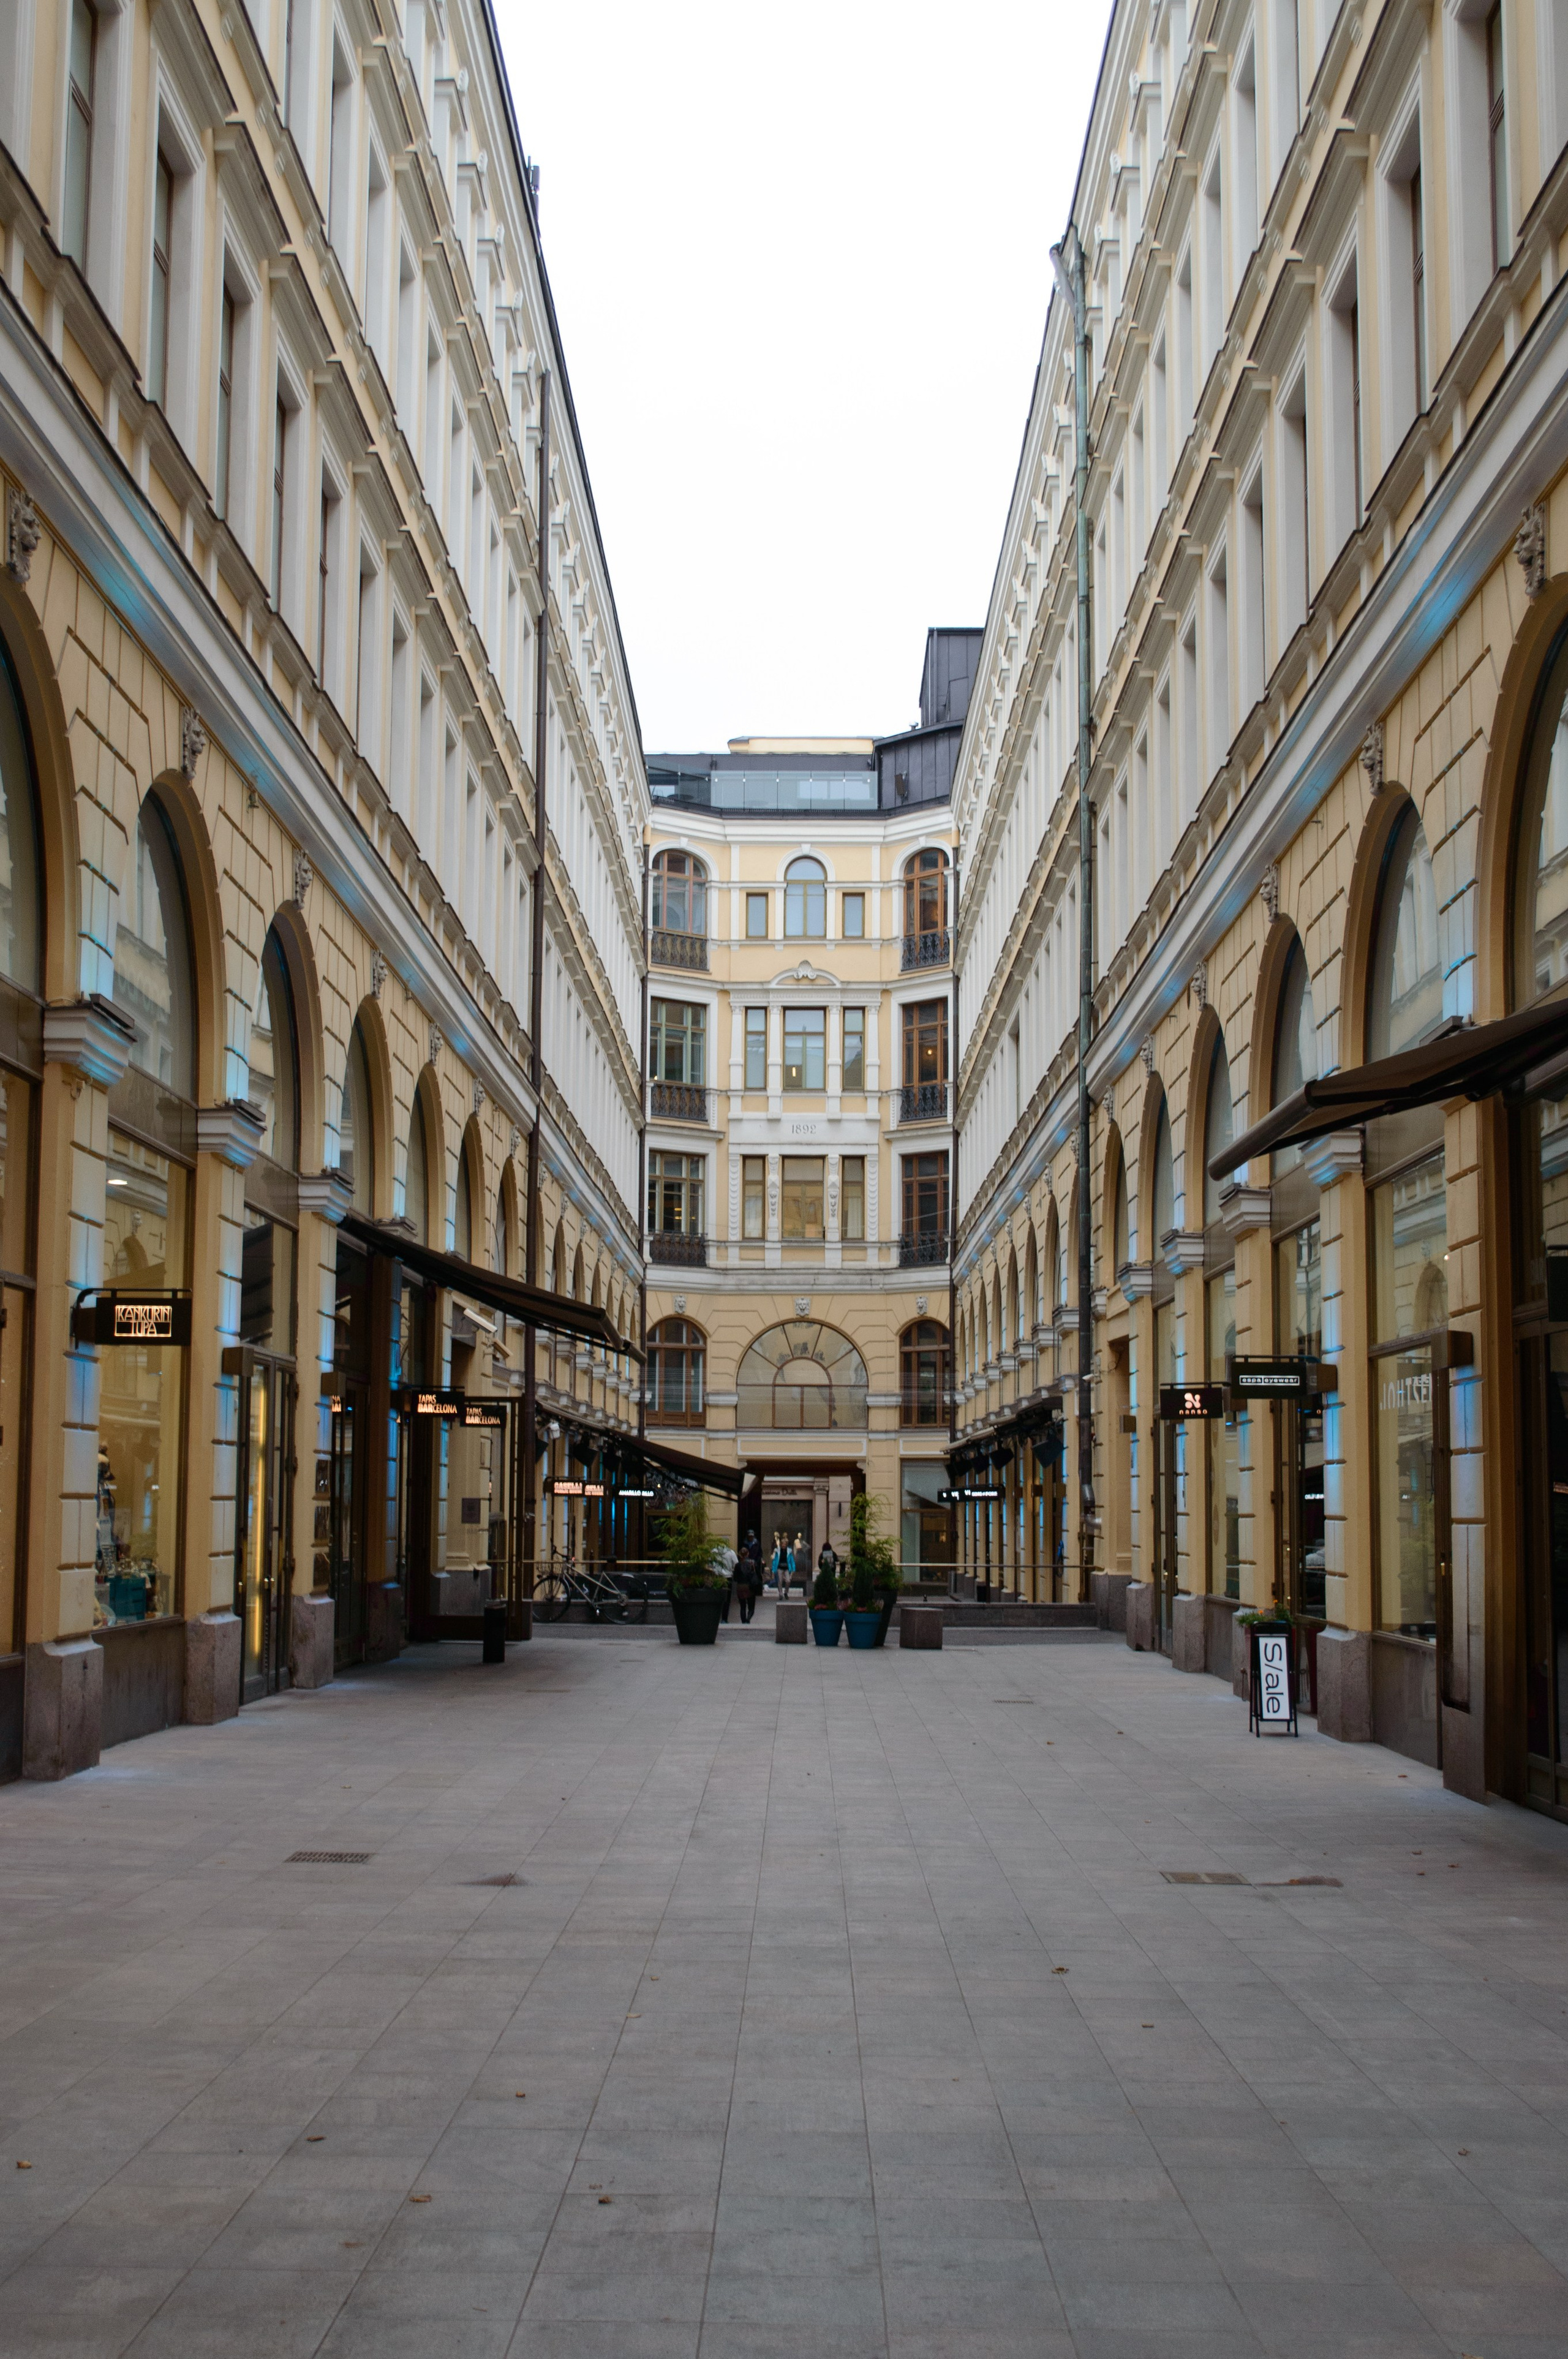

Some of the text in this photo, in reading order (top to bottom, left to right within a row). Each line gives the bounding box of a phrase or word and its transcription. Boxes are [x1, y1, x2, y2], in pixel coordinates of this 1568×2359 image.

[792, 1124, 816, 1134] 1892
[117, 1305, 172, 1322] KANKURIN
[130, 1320, 157, 1337] TUPA
[418, 1394, 437, 1404] TAPAS
[417, 1403, 458, 1414] BARCELONA
[466, 1407, 483, 1416] TAPAS
[465, 1415, 500, 1425] BARCELONA
[1264, 1643, 1283, 1713] S/ale
